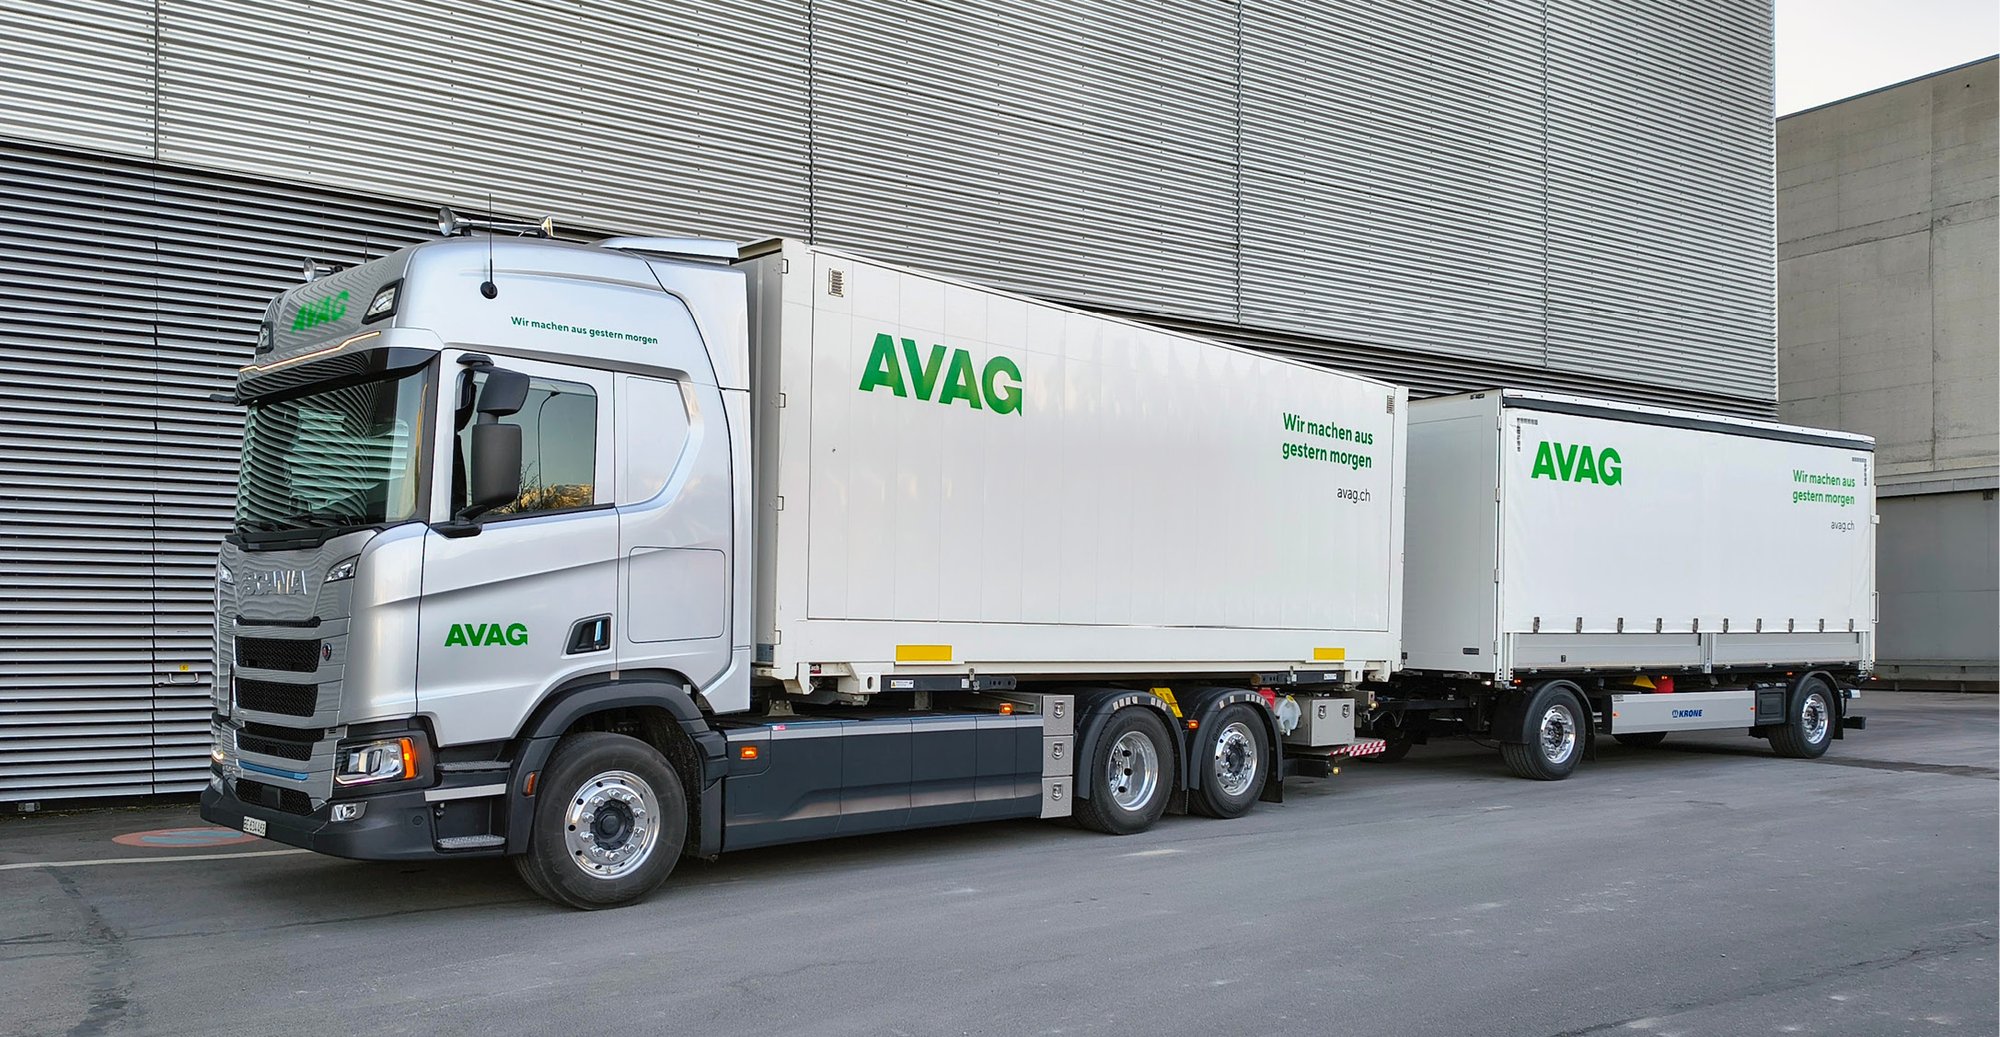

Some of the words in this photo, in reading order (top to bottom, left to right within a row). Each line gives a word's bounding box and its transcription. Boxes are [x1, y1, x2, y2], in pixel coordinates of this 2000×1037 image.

[290, 289, 351, 335] AVAG
[510, 316, 529, 327] Wir
[531, 321, 569, 333] machen
[571, 326, 587, 335] aus
[589, 328, 624, 340] gestern
[625, 333, 658, 345] morgen
[858, 332, 1023, 417] AVAG
[1282, 411, 1305, 433] Wir
[1307, 421, 1352, 442] machen
[1354, 430, 1374, 445] aus
[1282, 441, 1327, 461] gestern
[1329, 449, 1372, 471] morgen
[1530, 440, 1622, 487] AVAG
[1792, 469, 1808, 483] Wir
[1809, 473, 1841, 486] machen
[1842, 477, 1856, 488] aus
[1336, 487, 1371, 504] avag.ch
[1792, 490, 1824, 504] gestern
[1824, 493, 1855, 507] morgen
[1830, 520, 1855, 533] avag.ch
[444, 622, 529, 648] AVAG
[1678, 709, 1703, 718] KRONE
